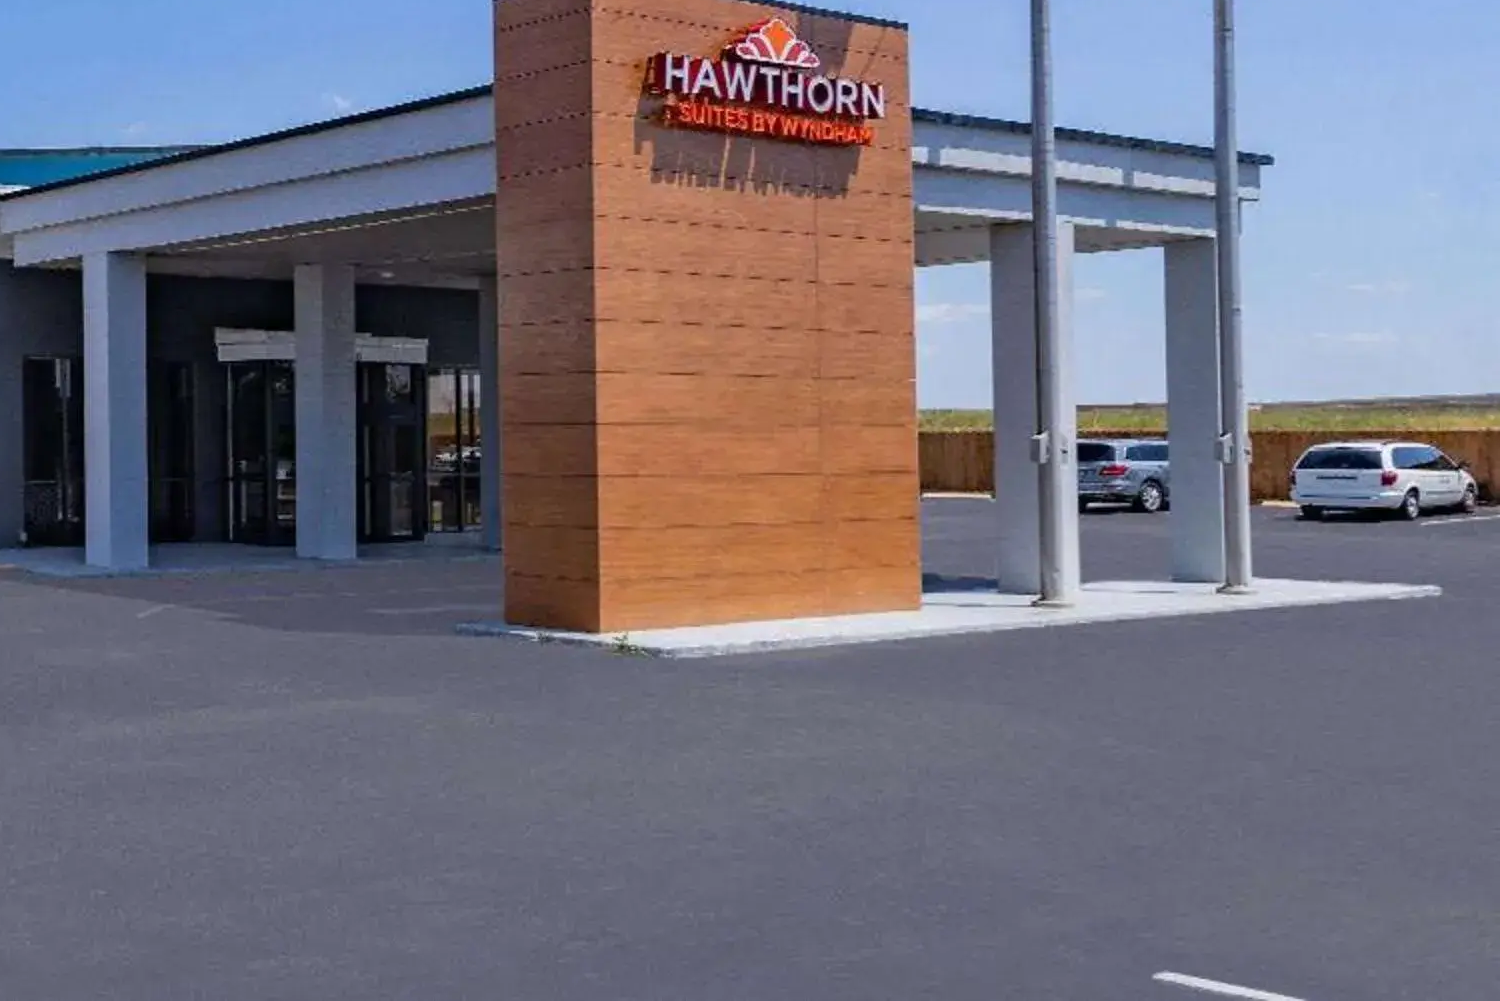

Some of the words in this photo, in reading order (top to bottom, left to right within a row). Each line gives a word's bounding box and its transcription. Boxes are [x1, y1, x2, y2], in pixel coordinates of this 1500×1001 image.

[665, 52, 886, 118] HAWTHORN
[679, 101, 749, 130] SUITES
[752, 113, 777, 133] BY
[780, 117, 874, 144] WYNDHAM
